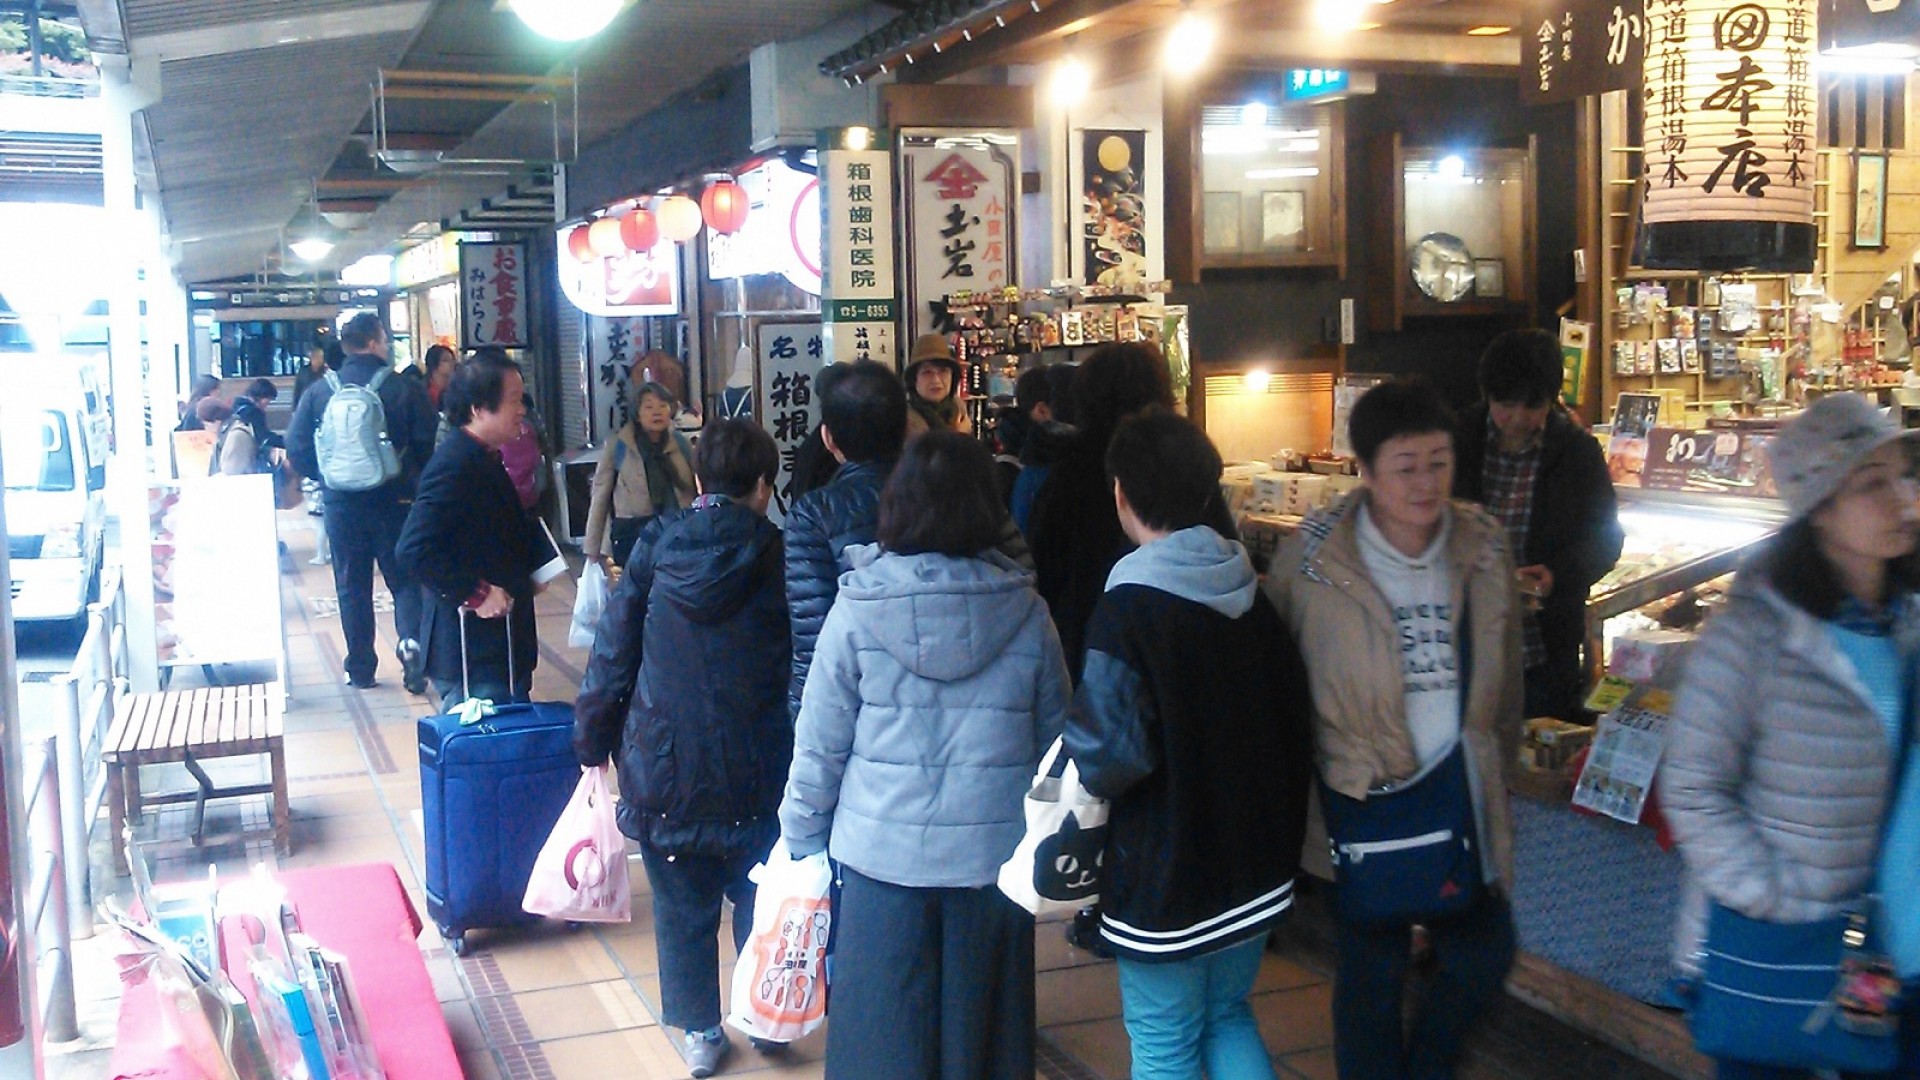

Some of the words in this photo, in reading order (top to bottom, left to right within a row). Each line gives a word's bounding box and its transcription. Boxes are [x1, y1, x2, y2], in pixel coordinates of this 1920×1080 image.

[846, 162, 876, 288] 箱根歯科医院
[470, 268, 486, 343] みはらし
